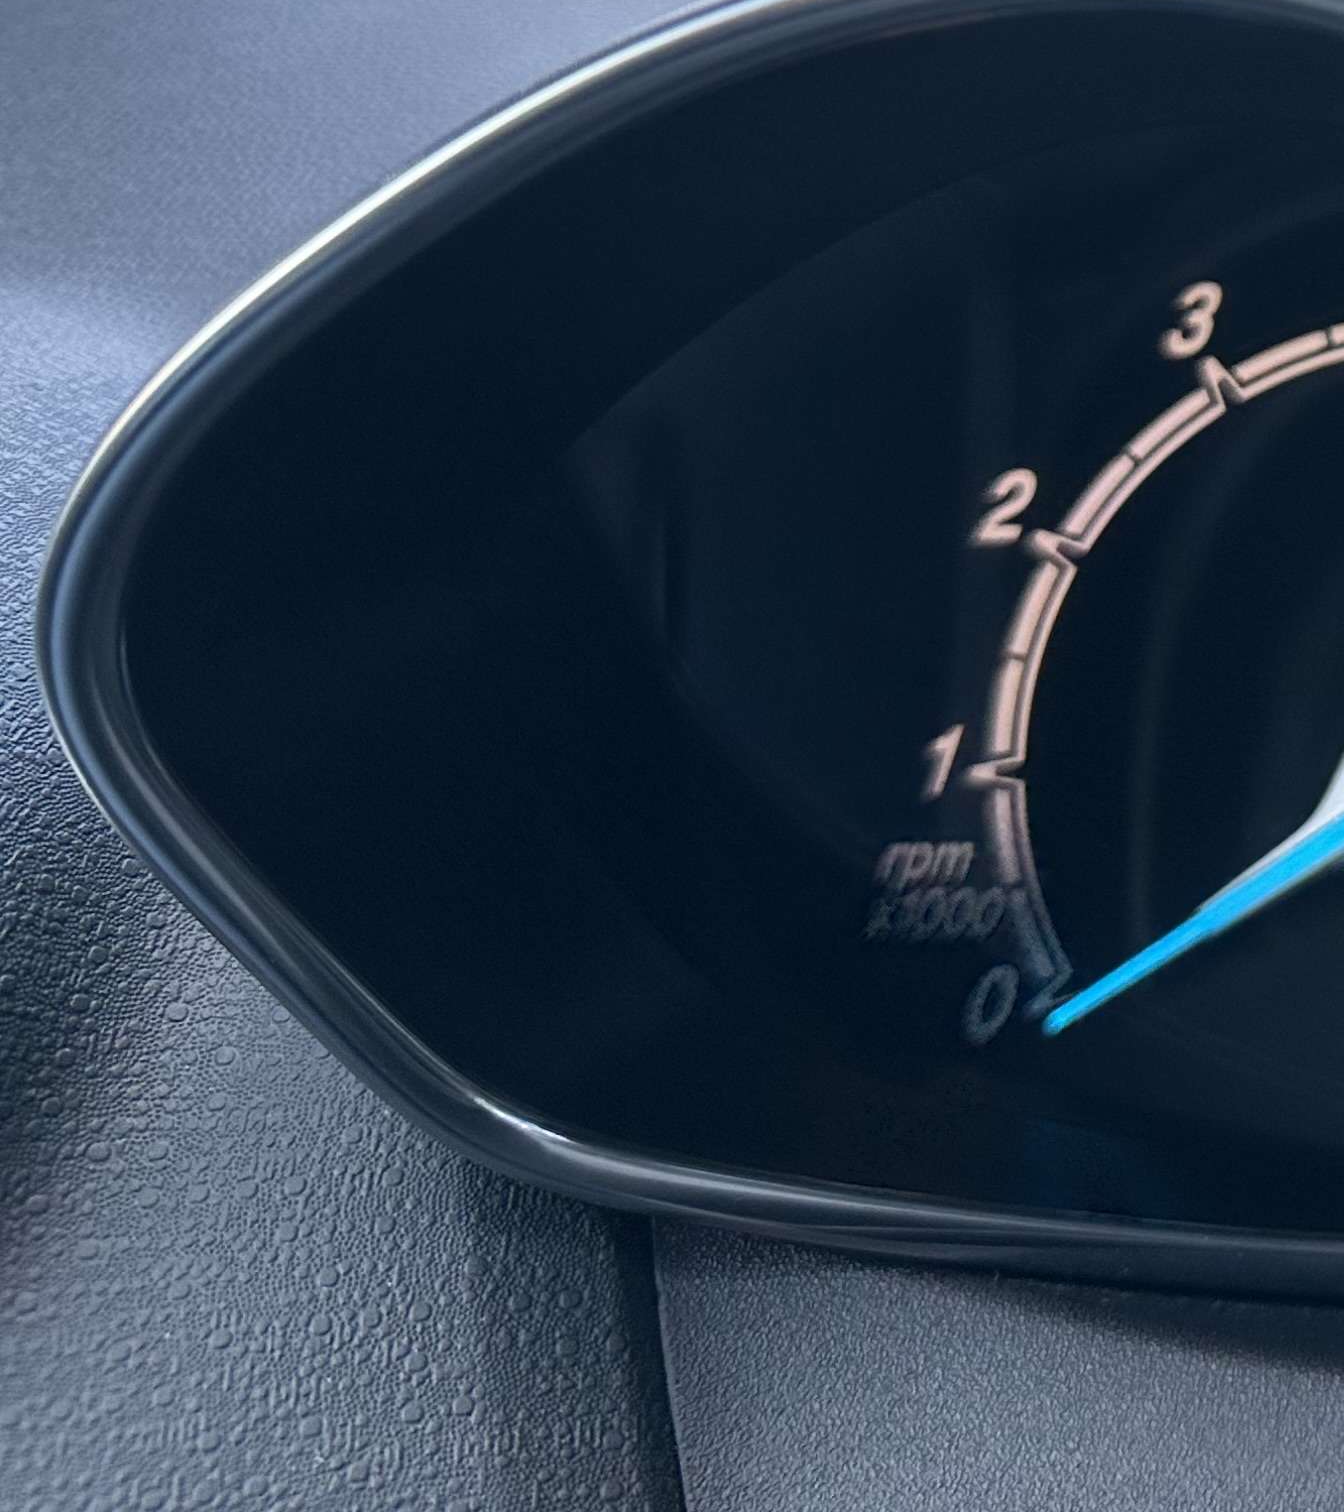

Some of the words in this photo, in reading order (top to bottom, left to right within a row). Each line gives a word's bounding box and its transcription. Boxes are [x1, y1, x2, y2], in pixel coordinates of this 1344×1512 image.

[1161, 281, 1225, 358] 3
[973, 468, 1039, 547] 2
[922, 724, 964, 798] 1
[874, 840, 976, 897] rpm
[860, 885, 1006, 943] x1000
[962, 963, 1020, 1046] 0
